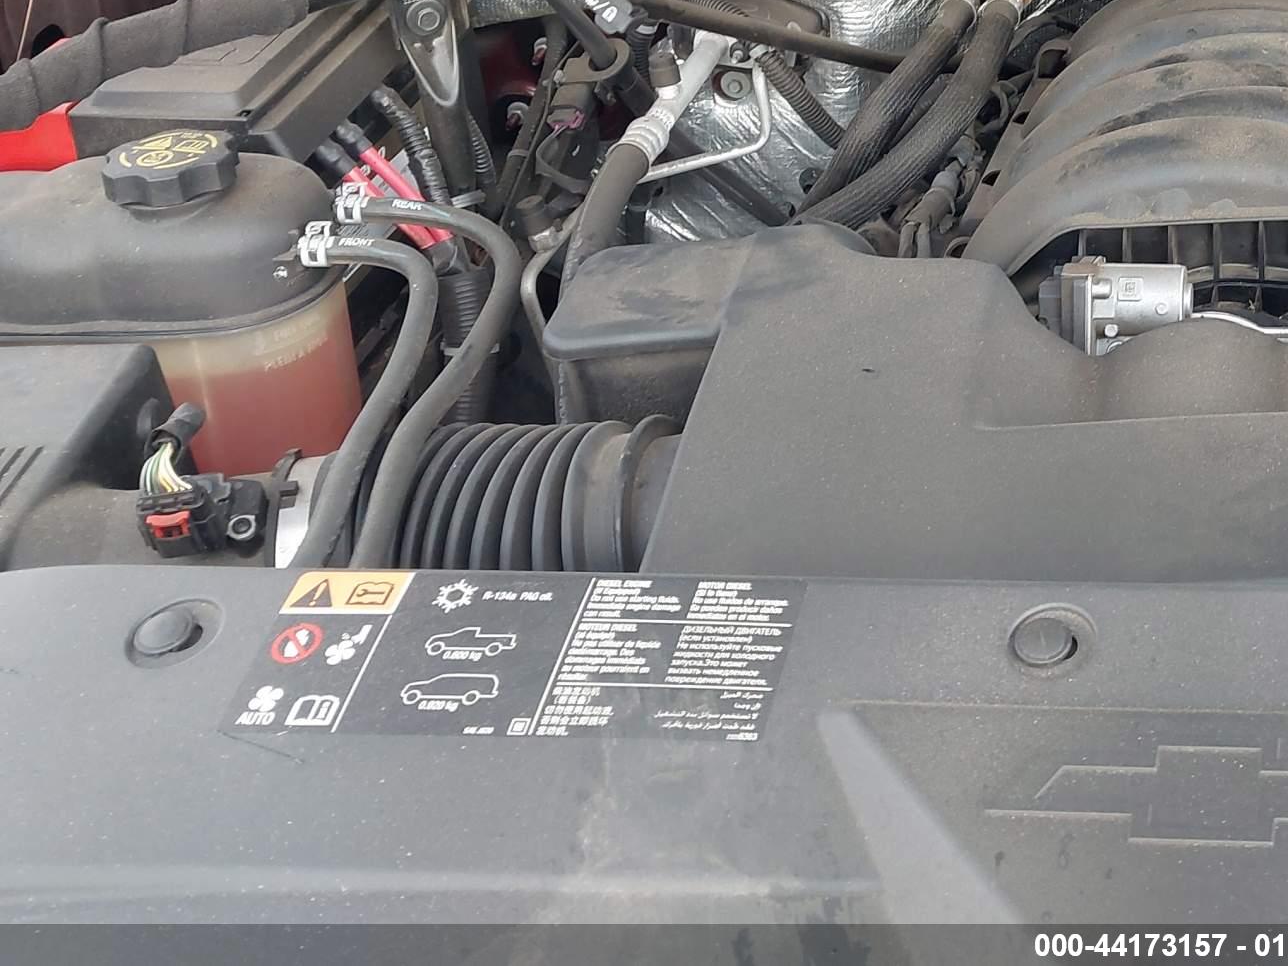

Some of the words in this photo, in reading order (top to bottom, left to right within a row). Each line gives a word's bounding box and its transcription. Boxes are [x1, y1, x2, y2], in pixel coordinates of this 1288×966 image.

[338, 237, 375, 247] FRONT
[482, 591, 518, 601] R-134a
[468, 651, 483, 662] kg
[444, 700, 460, 713] kg
[234, 711, 276, 725] AUTO
